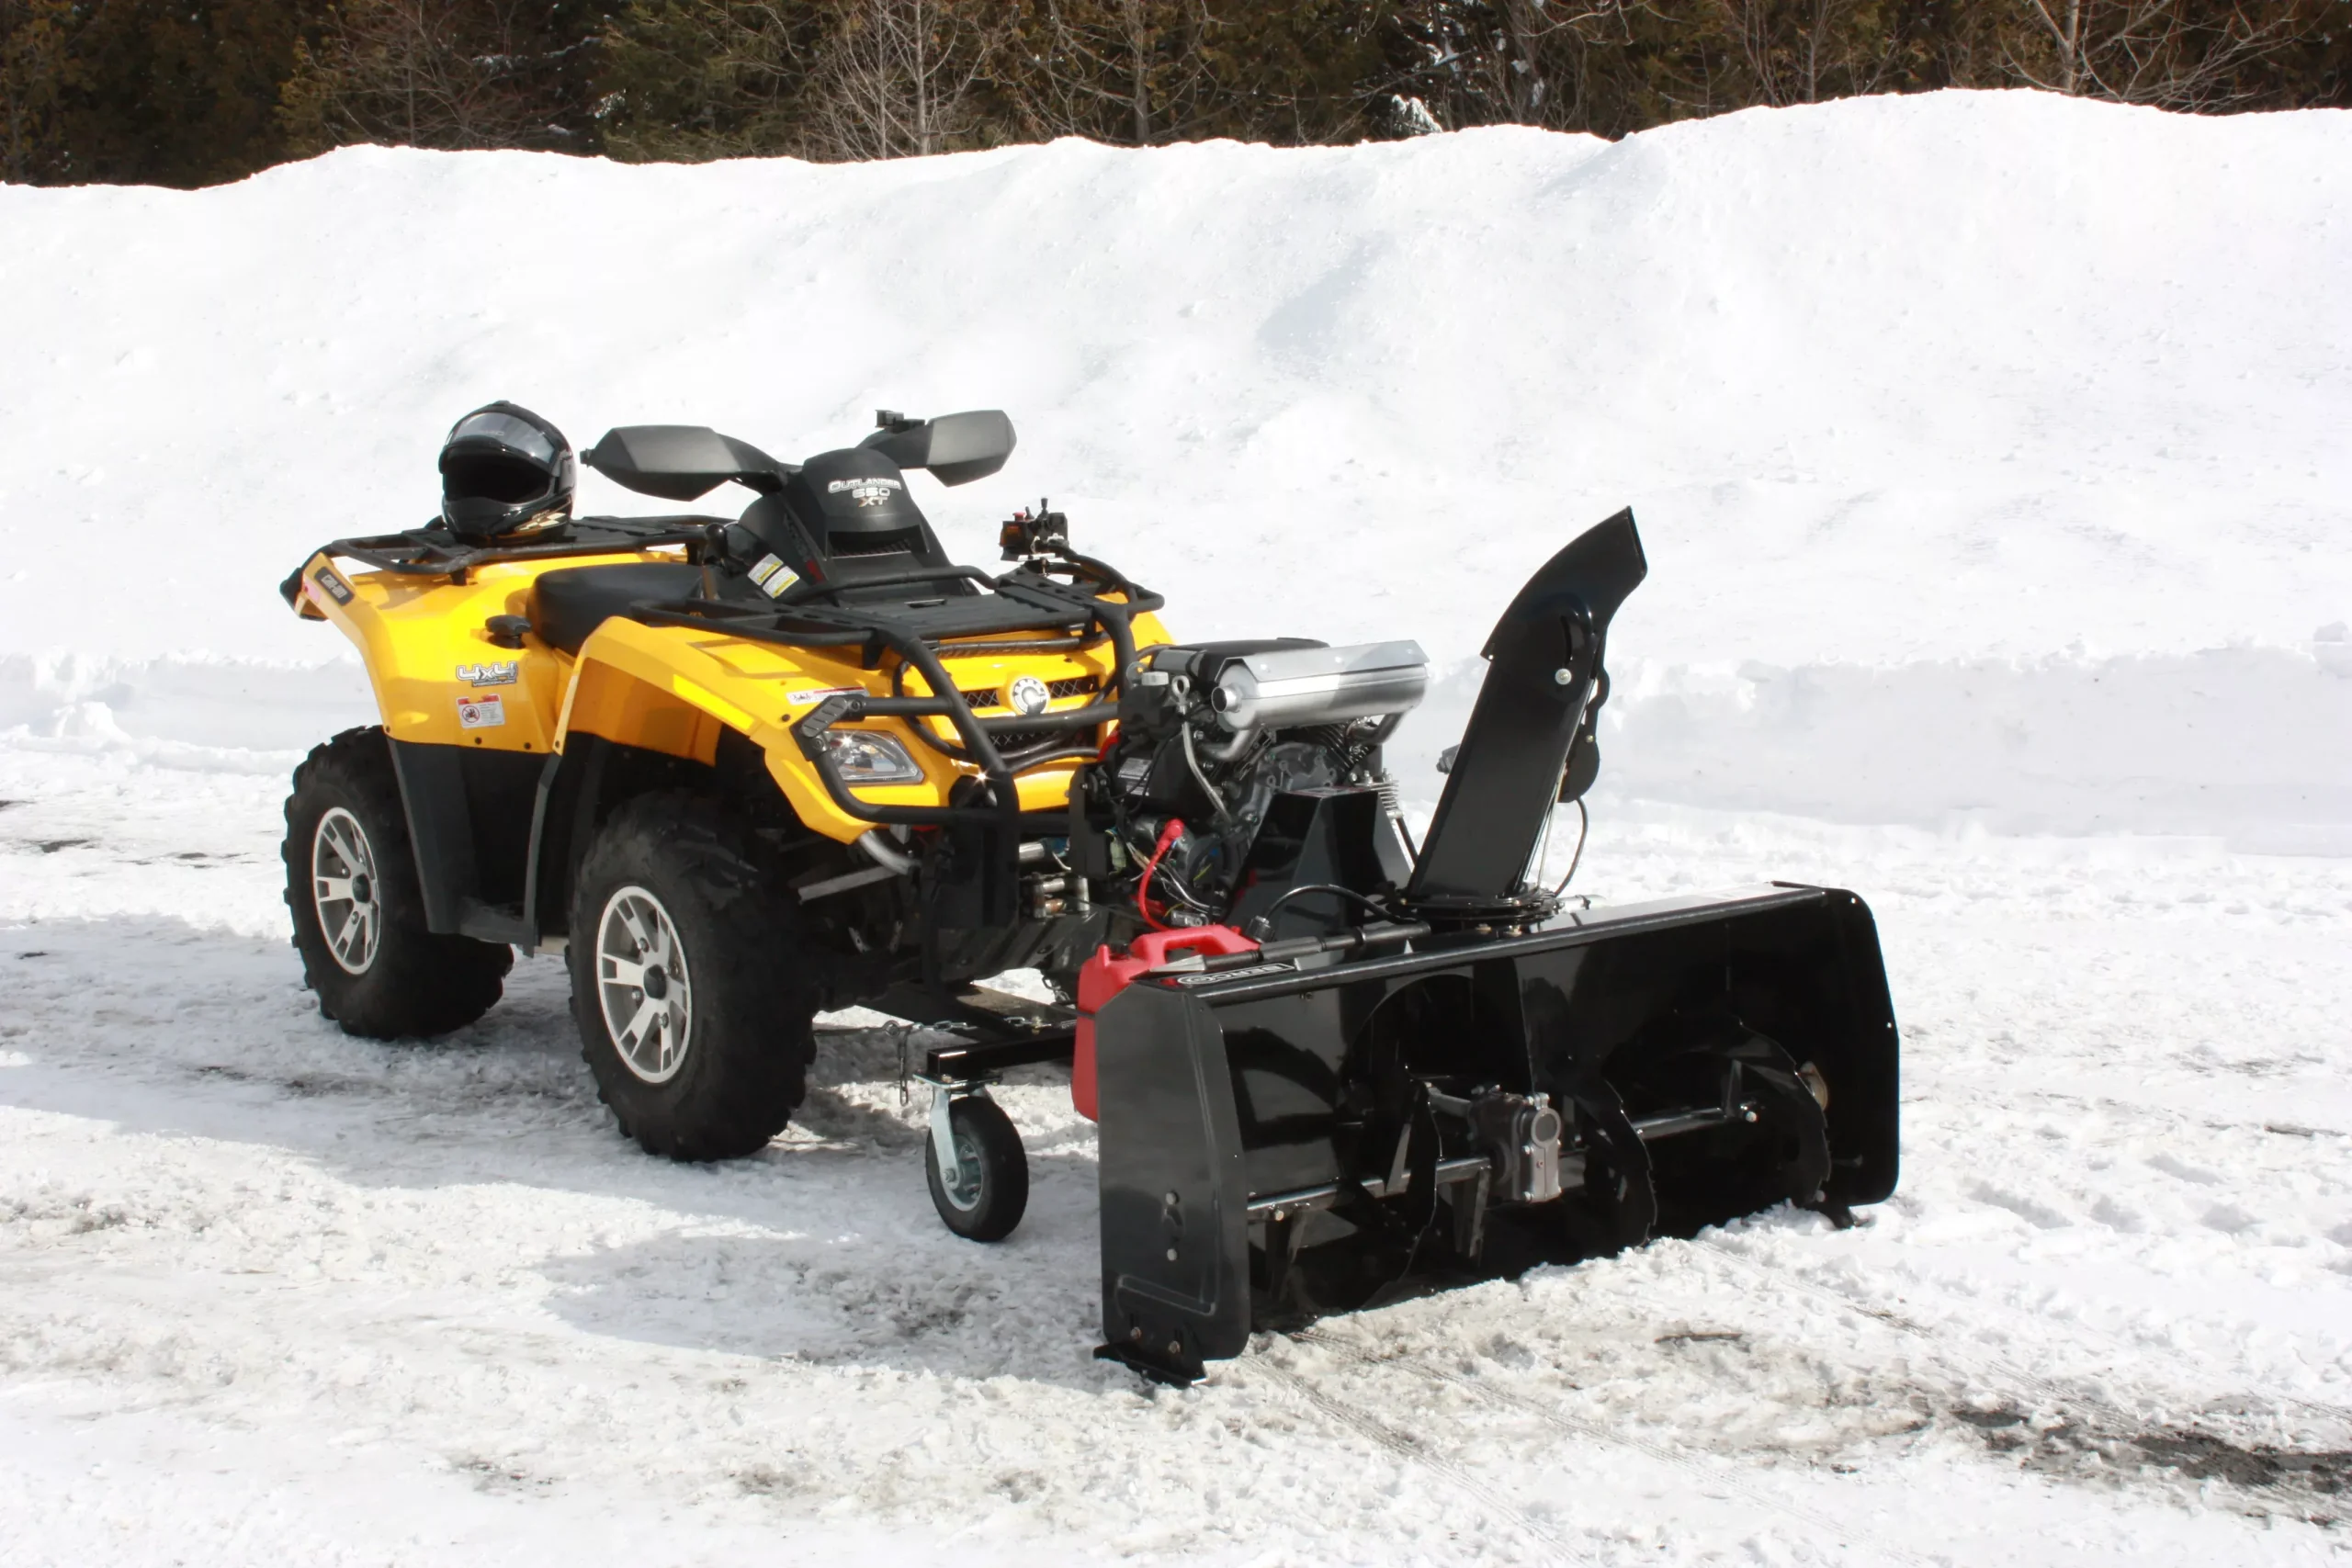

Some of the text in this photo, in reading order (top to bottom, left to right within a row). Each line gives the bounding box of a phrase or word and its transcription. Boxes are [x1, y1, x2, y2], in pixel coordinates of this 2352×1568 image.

[828, 478, 901, 493] OUTLANDER
[852, 487, 890, 498] 650
[858, 496, 888, 507] XT
